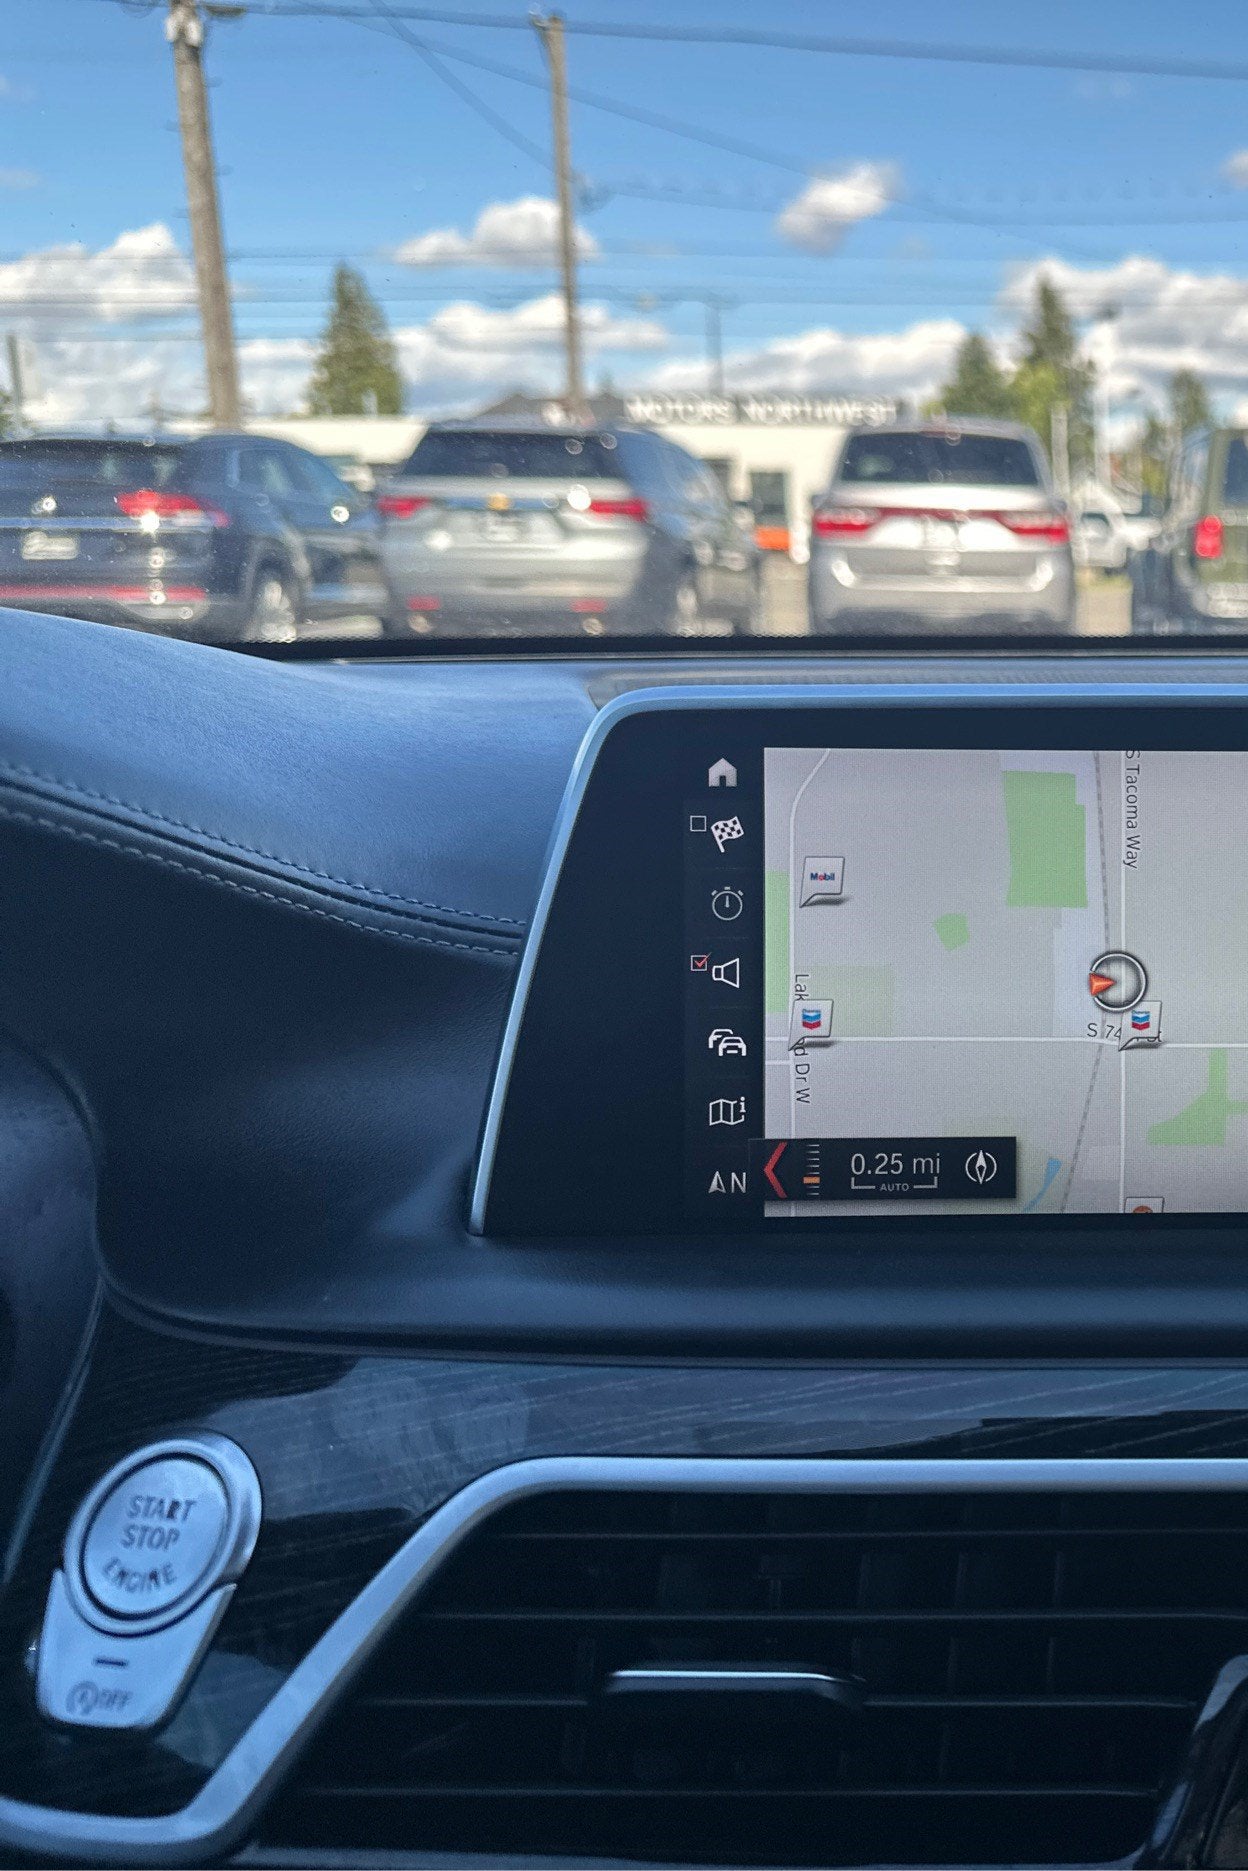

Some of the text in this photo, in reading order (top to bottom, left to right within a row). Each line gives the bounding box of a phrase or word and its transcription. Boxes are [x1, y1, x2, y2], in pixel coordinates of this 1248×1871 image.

[1126, 764, 1140, 829] Tacoma
[1123, 835, 1141, 869] Way
[810, 872, 835, 881] Mobil
[1086, 1022, 1098, 1038] S
[795, 1063, 810, 1083] Dr
[796, 1087, 811, 1104] W
[851, 1152, 940, 1175] 0.25 mi
[732, 1171, 747, 1194] N
[880, 1183, 909, 1192] AUTO
[126, 1495, 197, 1522] START
[121, 1524, 181, 1551] STOP
[103, 1557, 177, 1593] ENGINE
